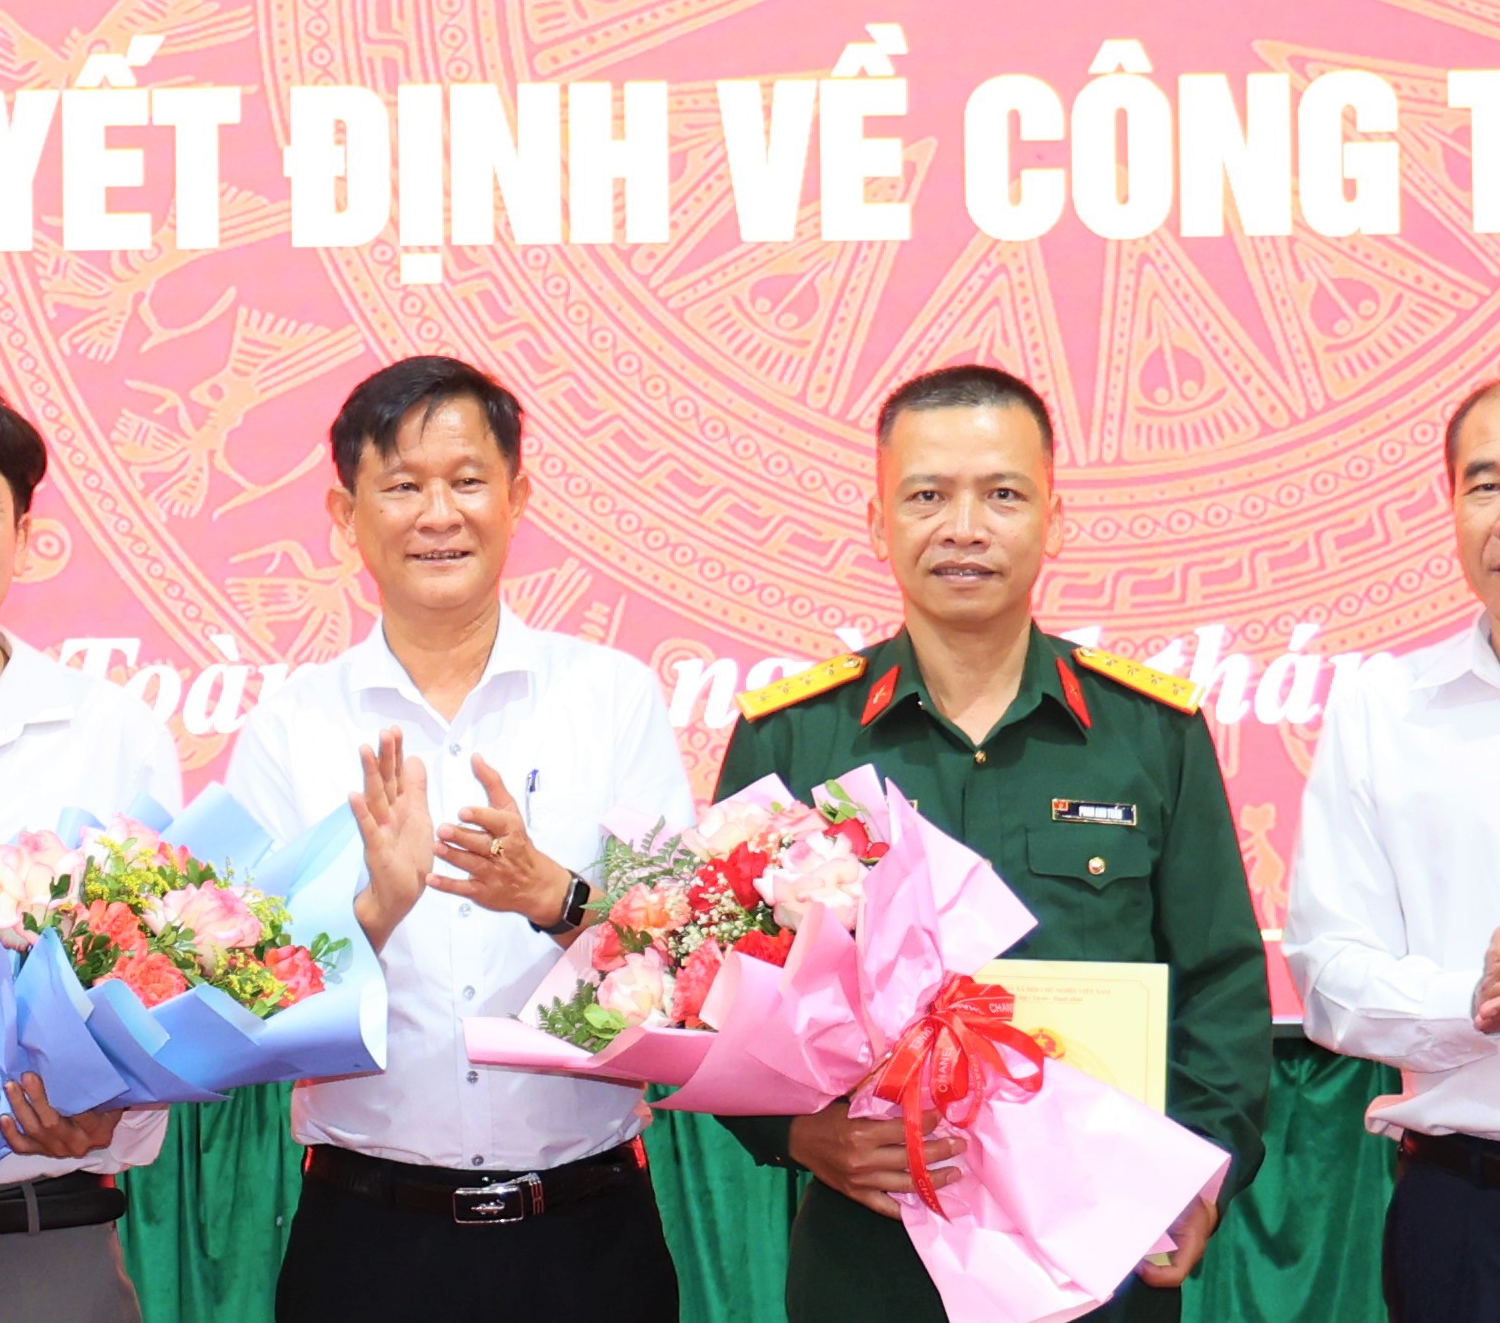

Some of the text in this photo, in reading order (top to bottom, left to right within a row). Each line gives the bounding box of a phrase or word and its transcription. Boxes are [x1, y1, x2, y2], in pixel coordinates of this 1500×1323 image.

[284, 82, 670, 278] ĐỊNH
[718, 25, 911, 242] VỀ
[965, 42, 1399, 240] CÔNG
